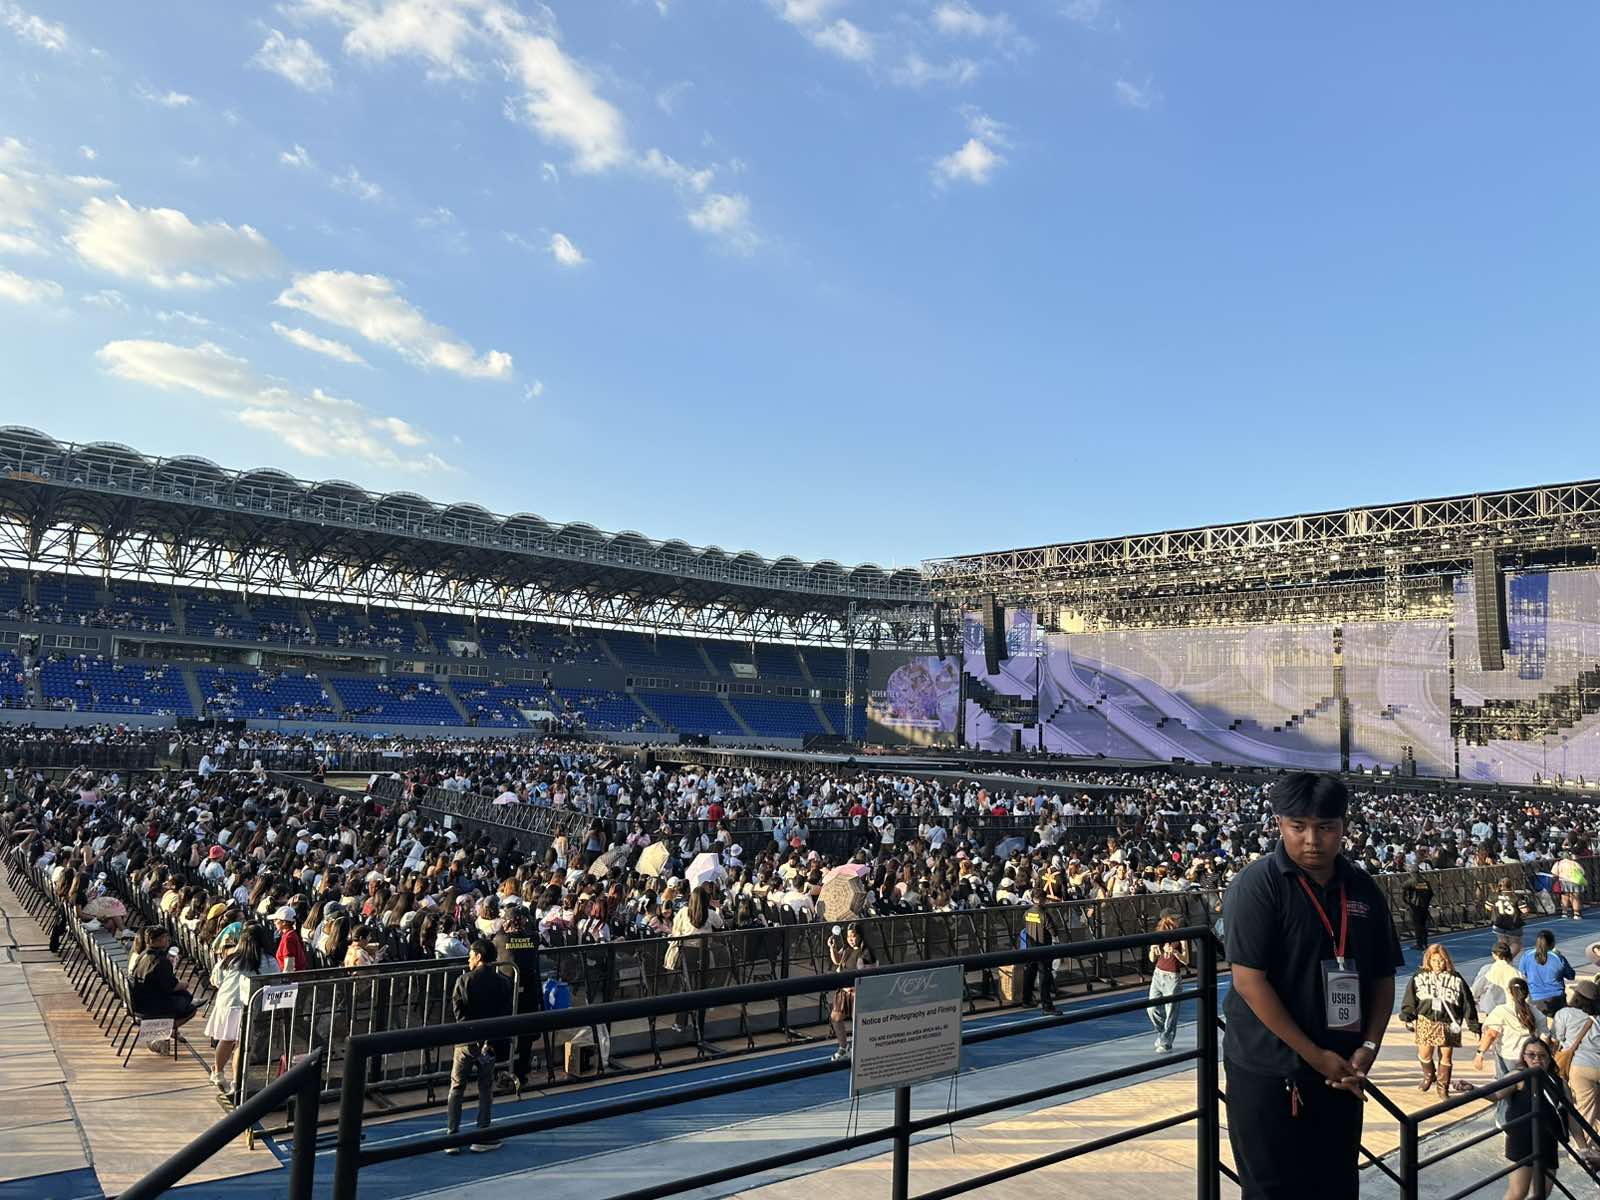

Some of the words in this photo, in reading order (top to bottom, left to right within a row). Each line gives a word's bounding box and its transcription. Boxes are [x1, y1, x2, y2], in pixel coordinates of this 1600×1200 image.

[1494, 899, 1515, 915] 13
[267, 991, 283, 1000] ZONE
[1331, 992, 1356, 1004] USHER
[861, 1016, 881, 1025] Notice
[882, 1015, 889, 1023] of
[889, 1011, 925, 1022] Photography
[926, 1008, 937, 1016] and
[937, 1005, 957, 1014] Filming
[1338, 1007, 1349, 1020] 69
